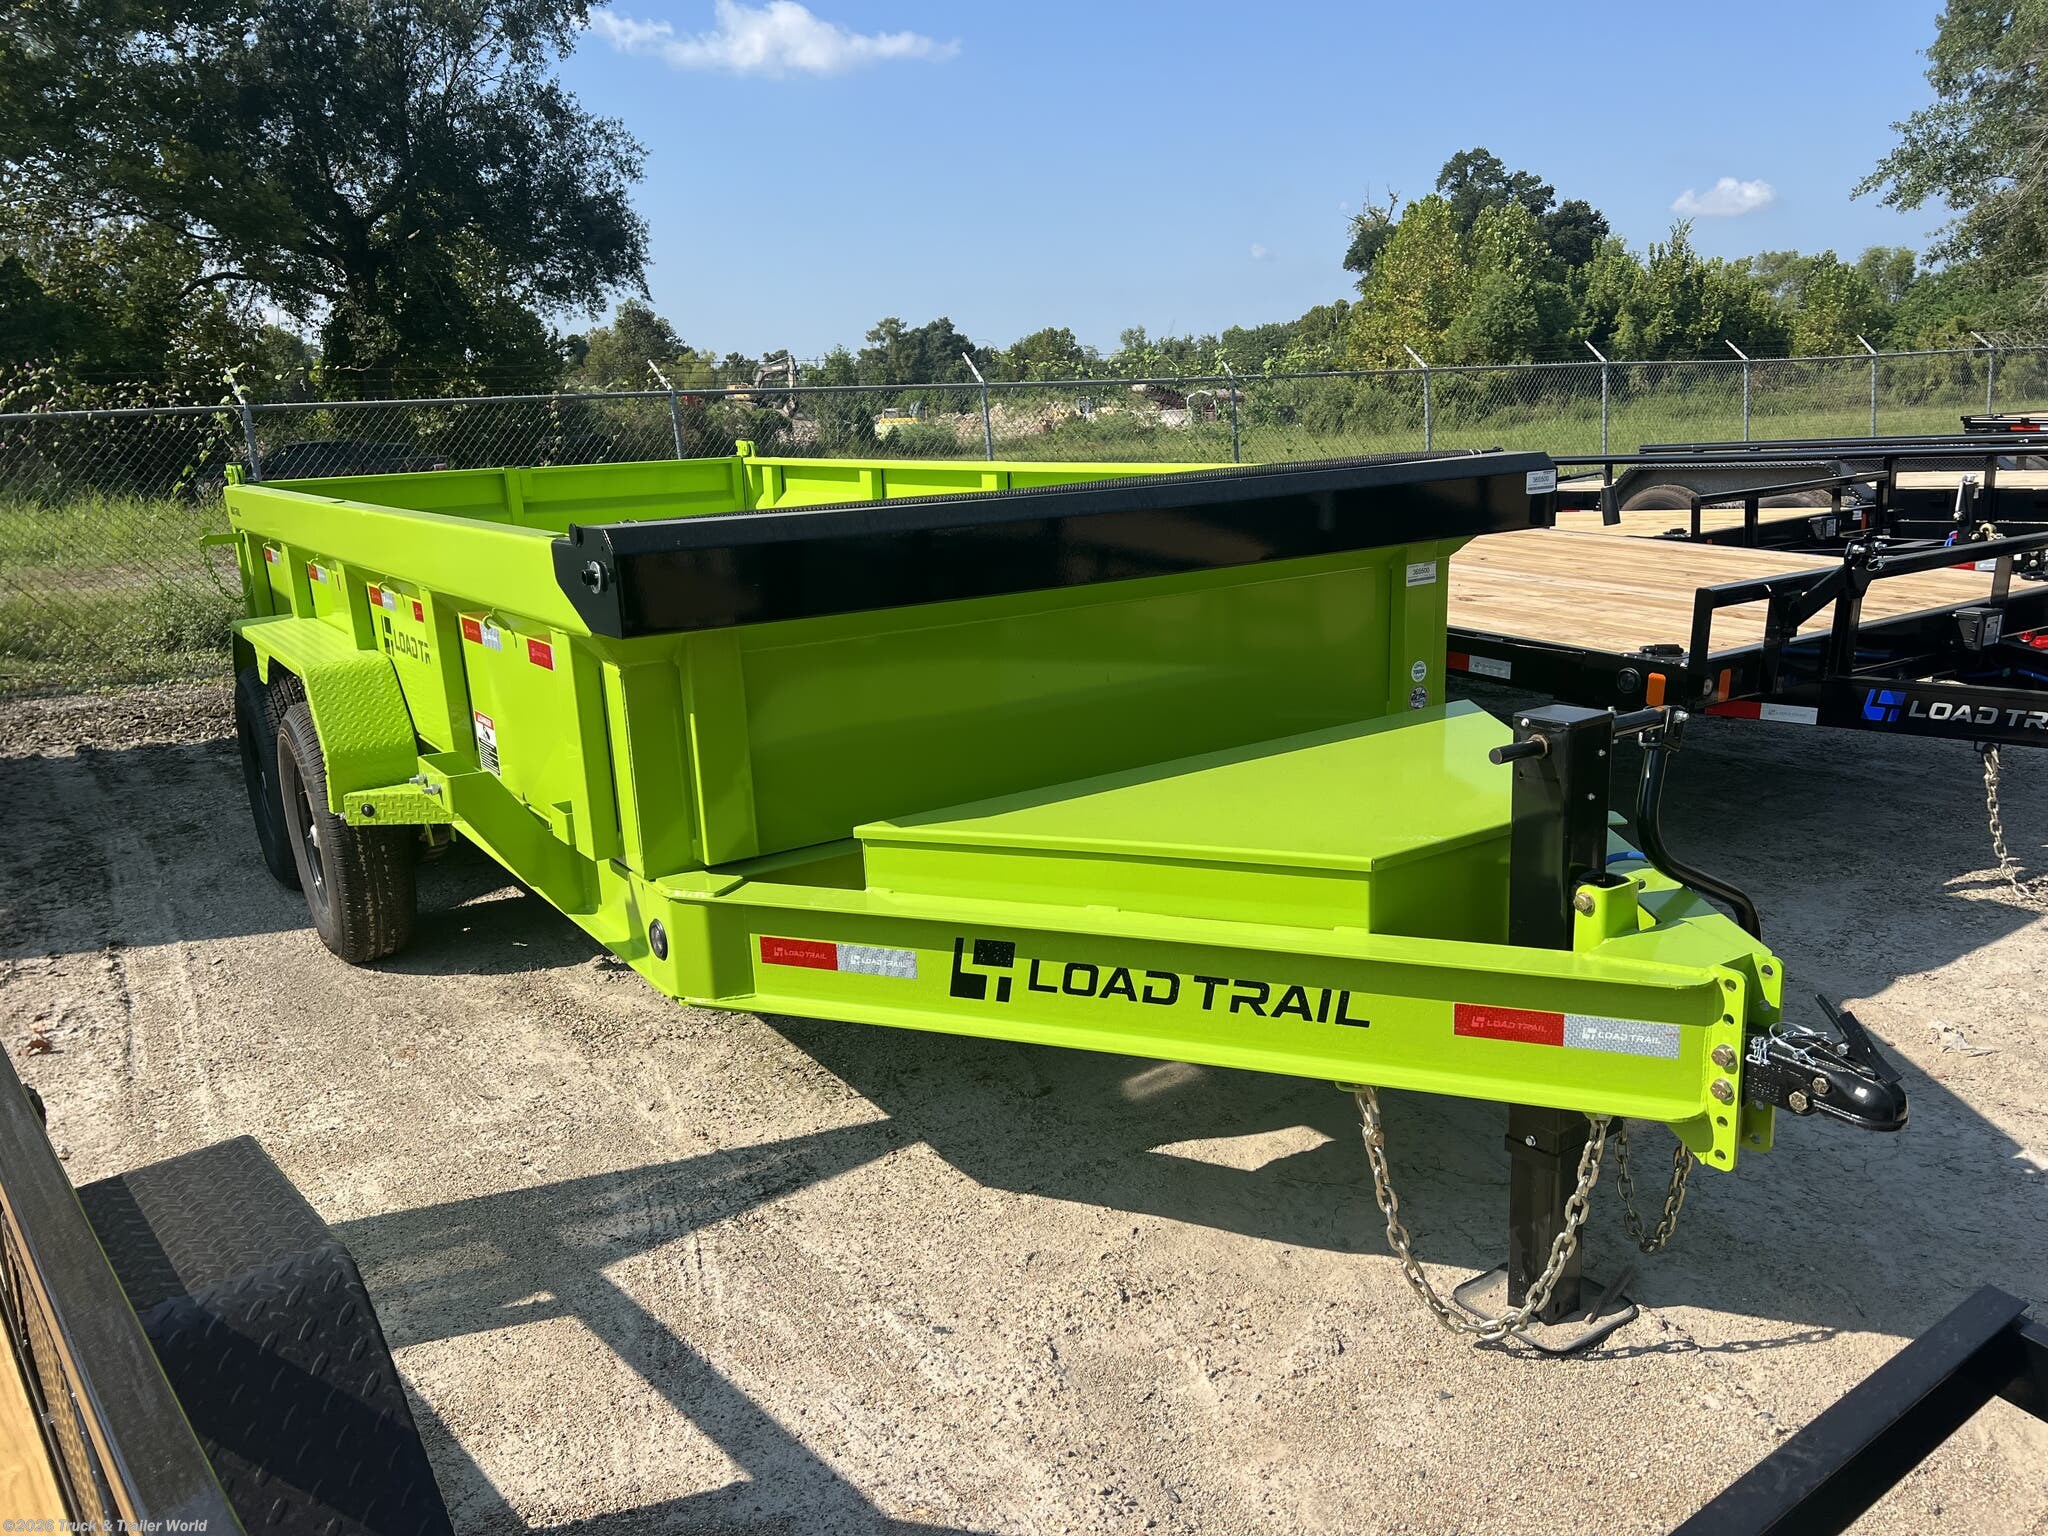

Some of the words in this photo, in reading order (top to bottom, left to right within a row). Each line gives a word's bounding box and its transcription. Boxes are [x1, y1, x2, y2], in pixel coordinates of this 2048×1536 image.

[393, 629, 418, 659] LOAD
[1908, 700, 1999, 725] LOAD
[2005, 708, 2048, 730] TR
[784, 949, 804, 958] LOAD
[804, 951, 827, 960] TRAIL
[861, 957, 882, 966] LOAD
[1027, 958, 1181, 1007] LOAD
[1193, 974, 1371, 1029] TRAIL
[1486, 1019, 1516, 1030] LOAD
[1517, 1022, 1547, 1033] TRAIL
[1598, 1031, 1627, 1042] LOAD
[1628, 1033, 1661, 1045] TRAIL
